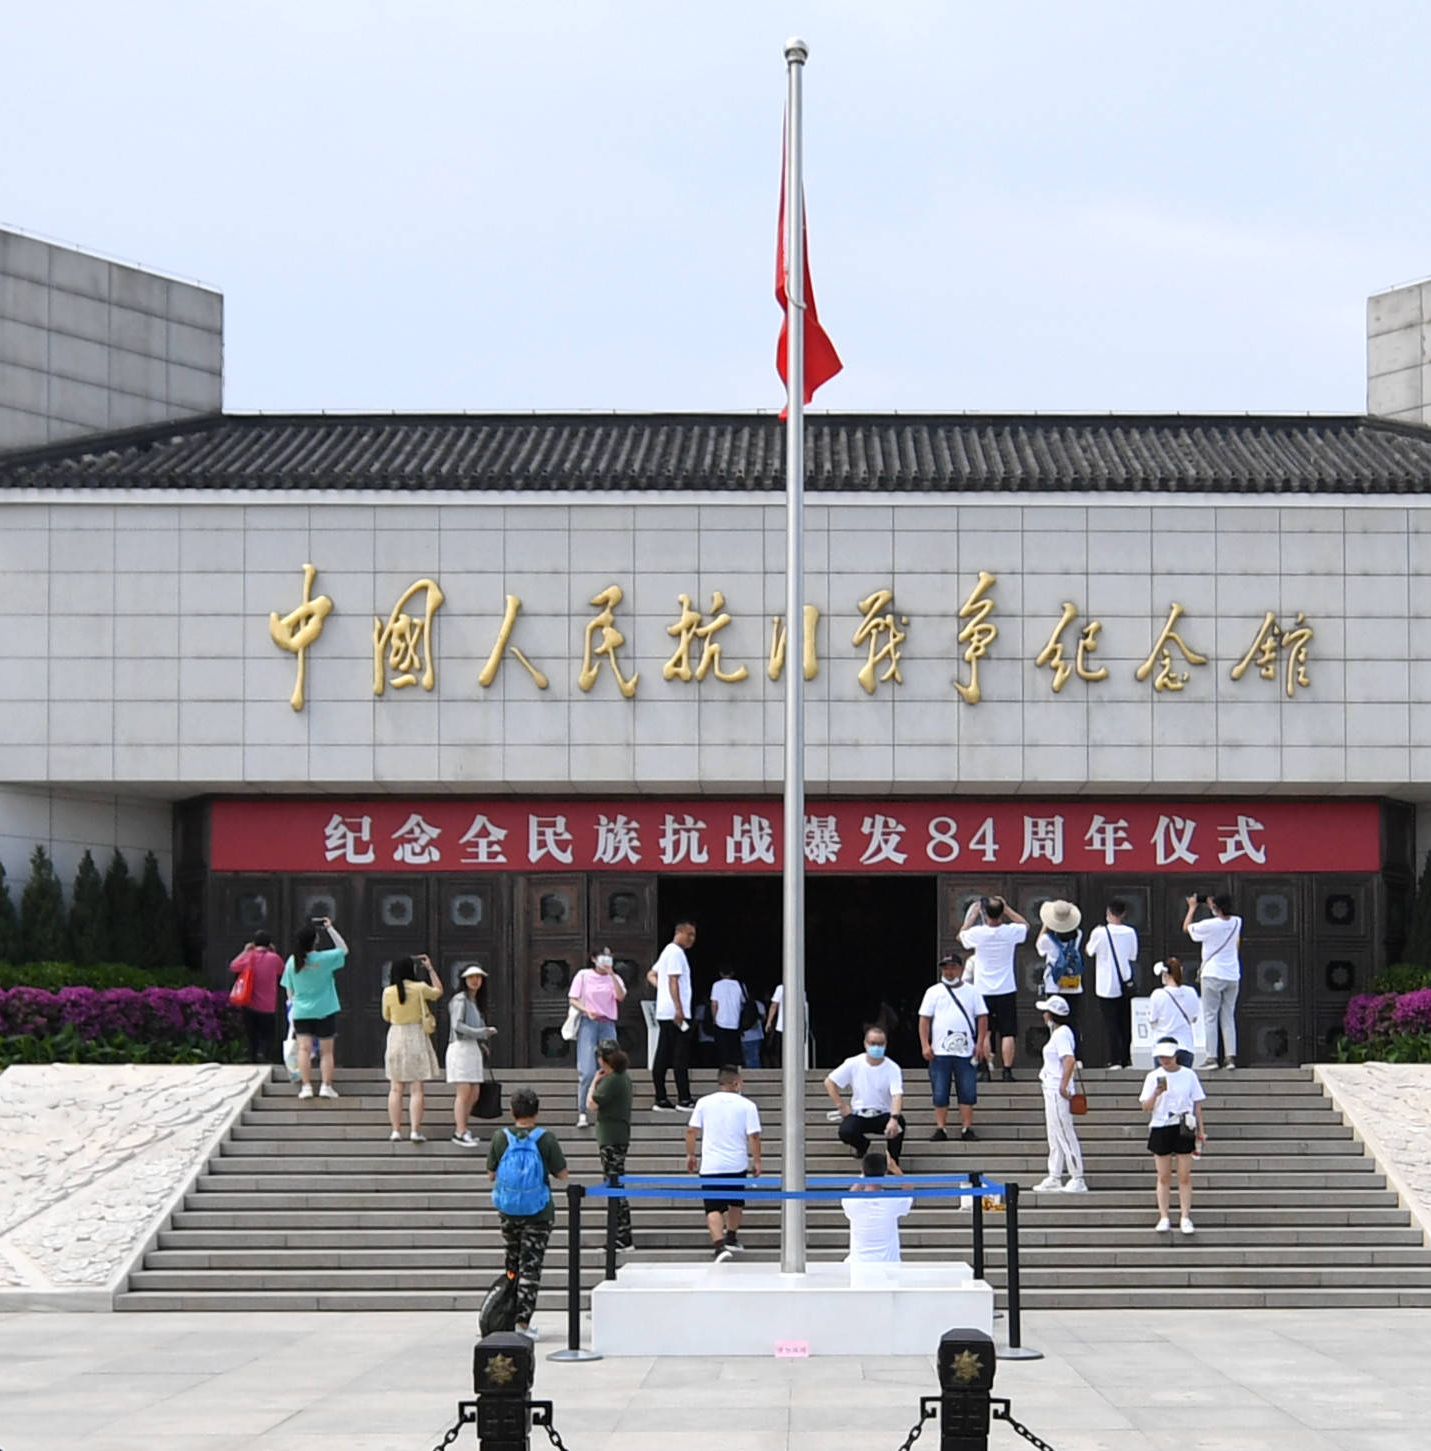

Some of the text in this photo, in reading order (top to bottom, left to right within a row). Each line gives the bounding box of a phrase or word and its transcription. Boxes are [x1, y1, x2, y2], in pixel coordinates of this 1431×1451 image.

[323, 812, 1267, 866] 纪念全民族抗战爆发84周年仪式
